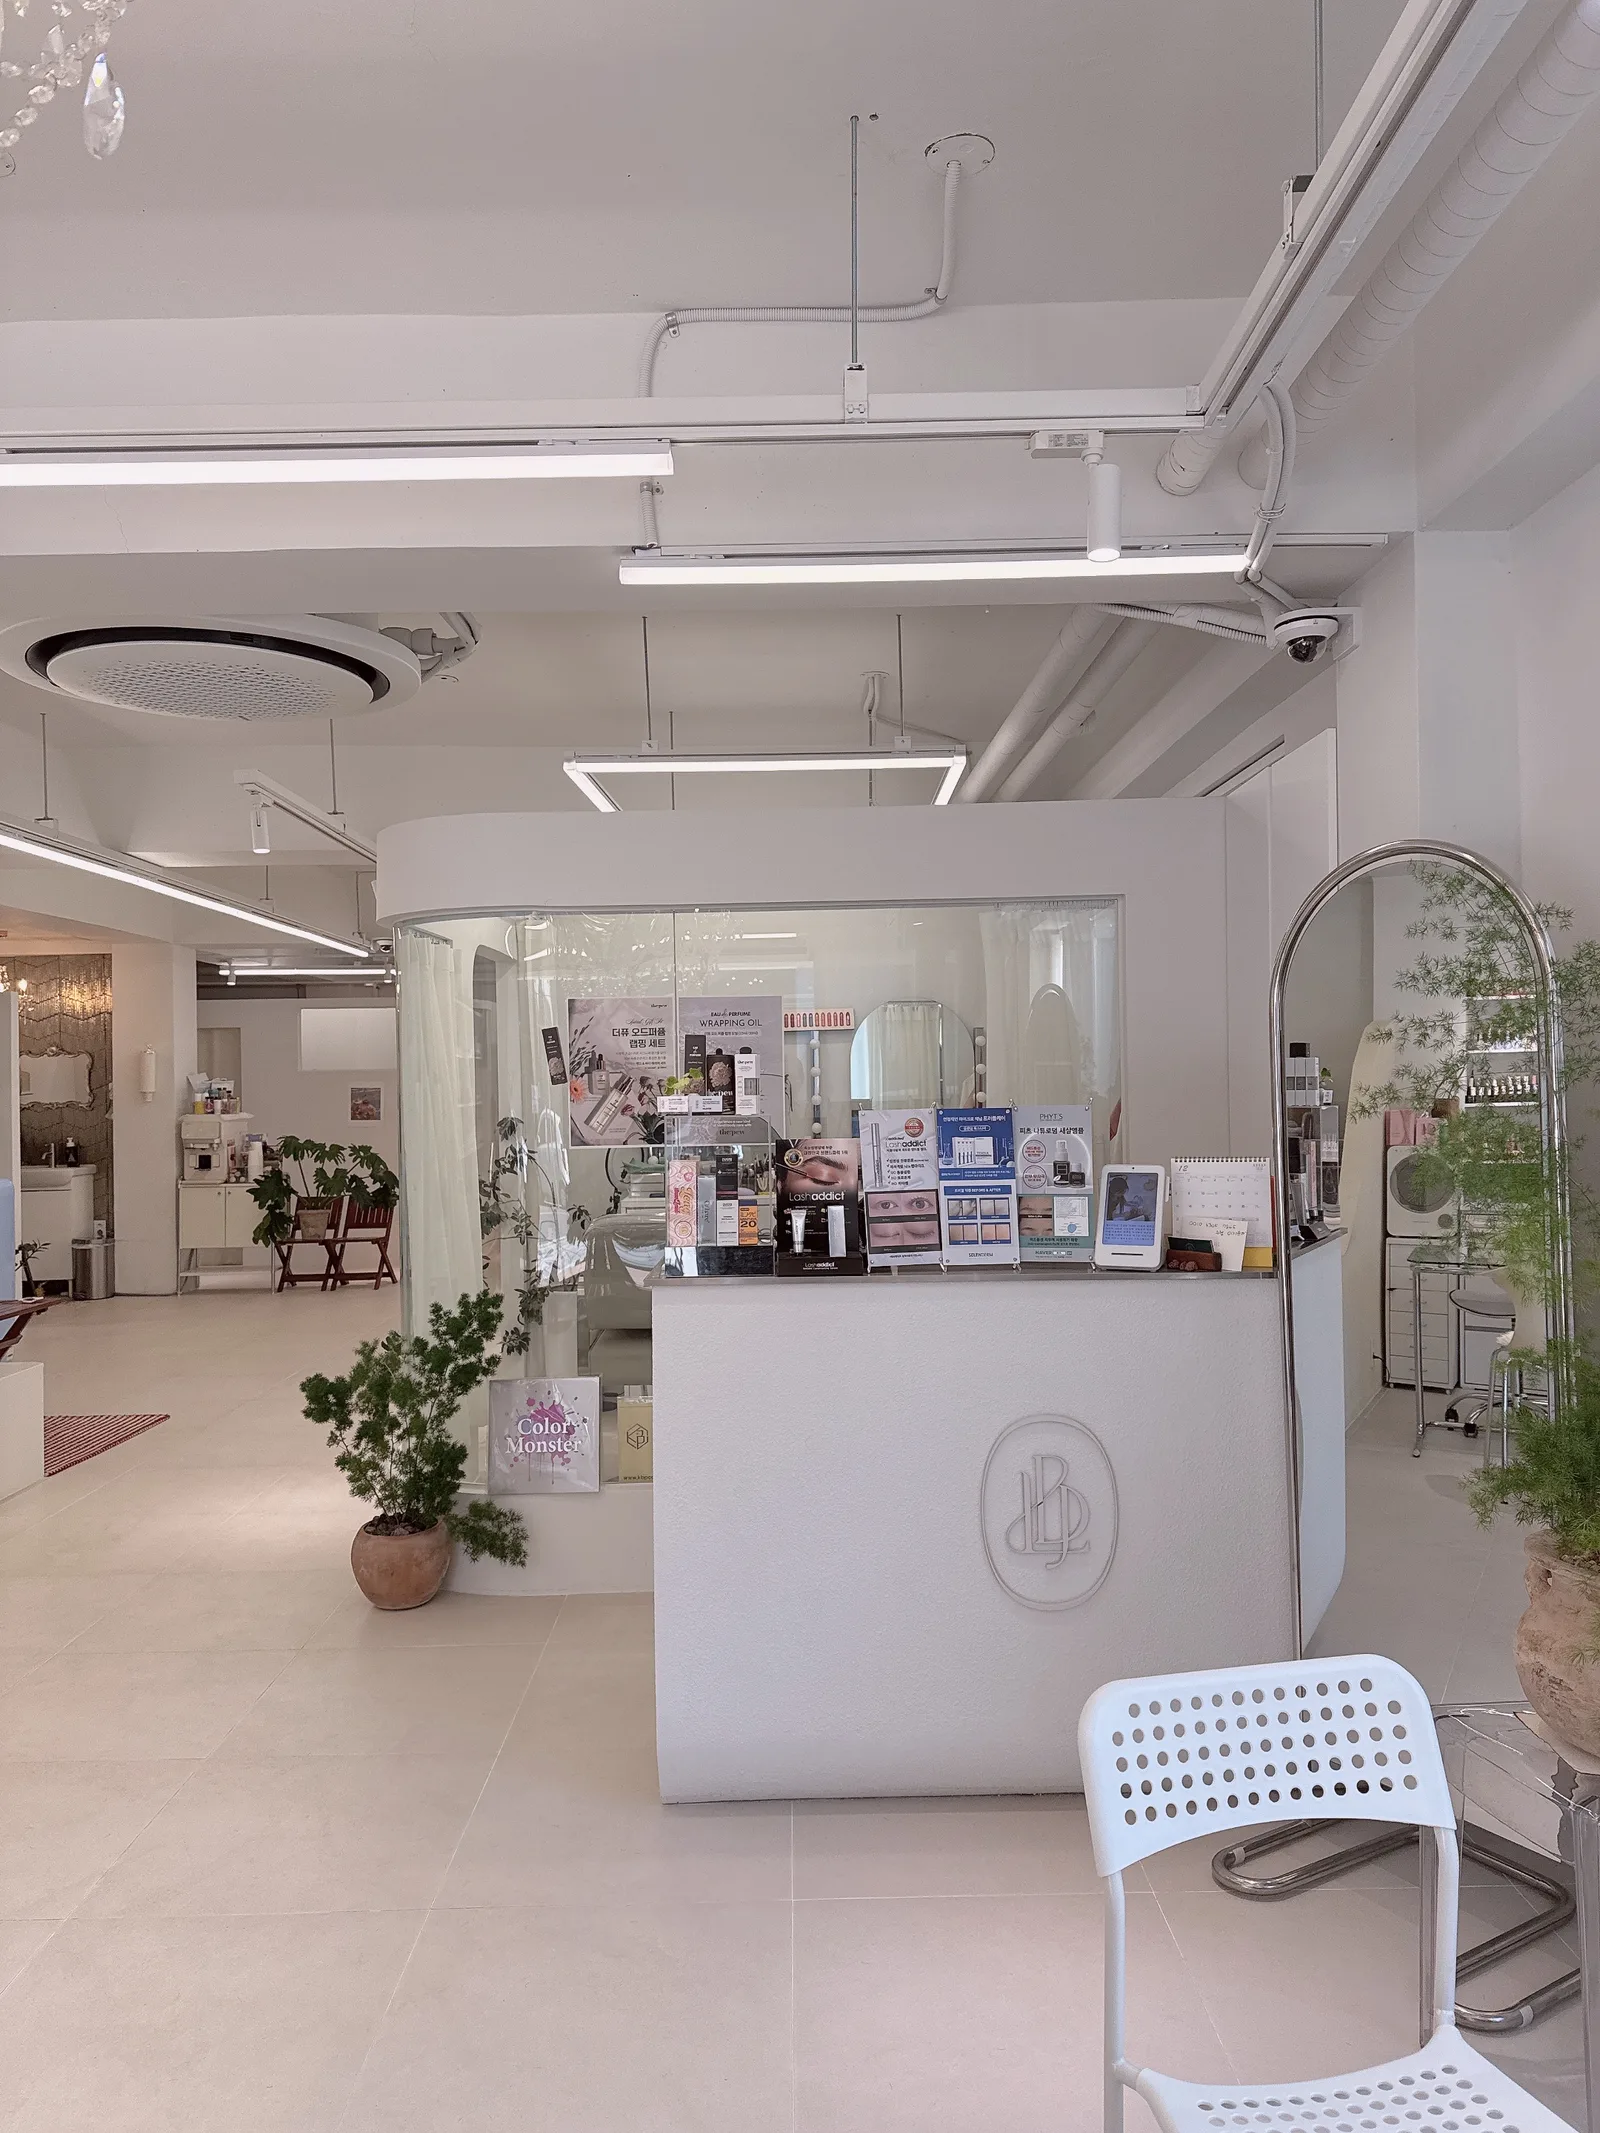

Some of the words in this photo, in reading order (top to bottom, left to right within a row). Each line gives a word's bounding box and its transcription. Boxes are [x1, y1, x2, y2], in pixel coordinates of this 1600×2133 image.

[612, 1028, 629, 1037] 더퓨
[631, 1027, 666, 1037] 오드퍼퓸
[629, 1039, 647, 1048] 랩핑
[648, 1038, 666, 1048] 세트
[789, 1191, 845, 1201] Lashaddict
[740, 1220, 757, 1228] 20
[517, 1417, 569, 1435] Color
[505, 1437, 582, 1454] Monster
